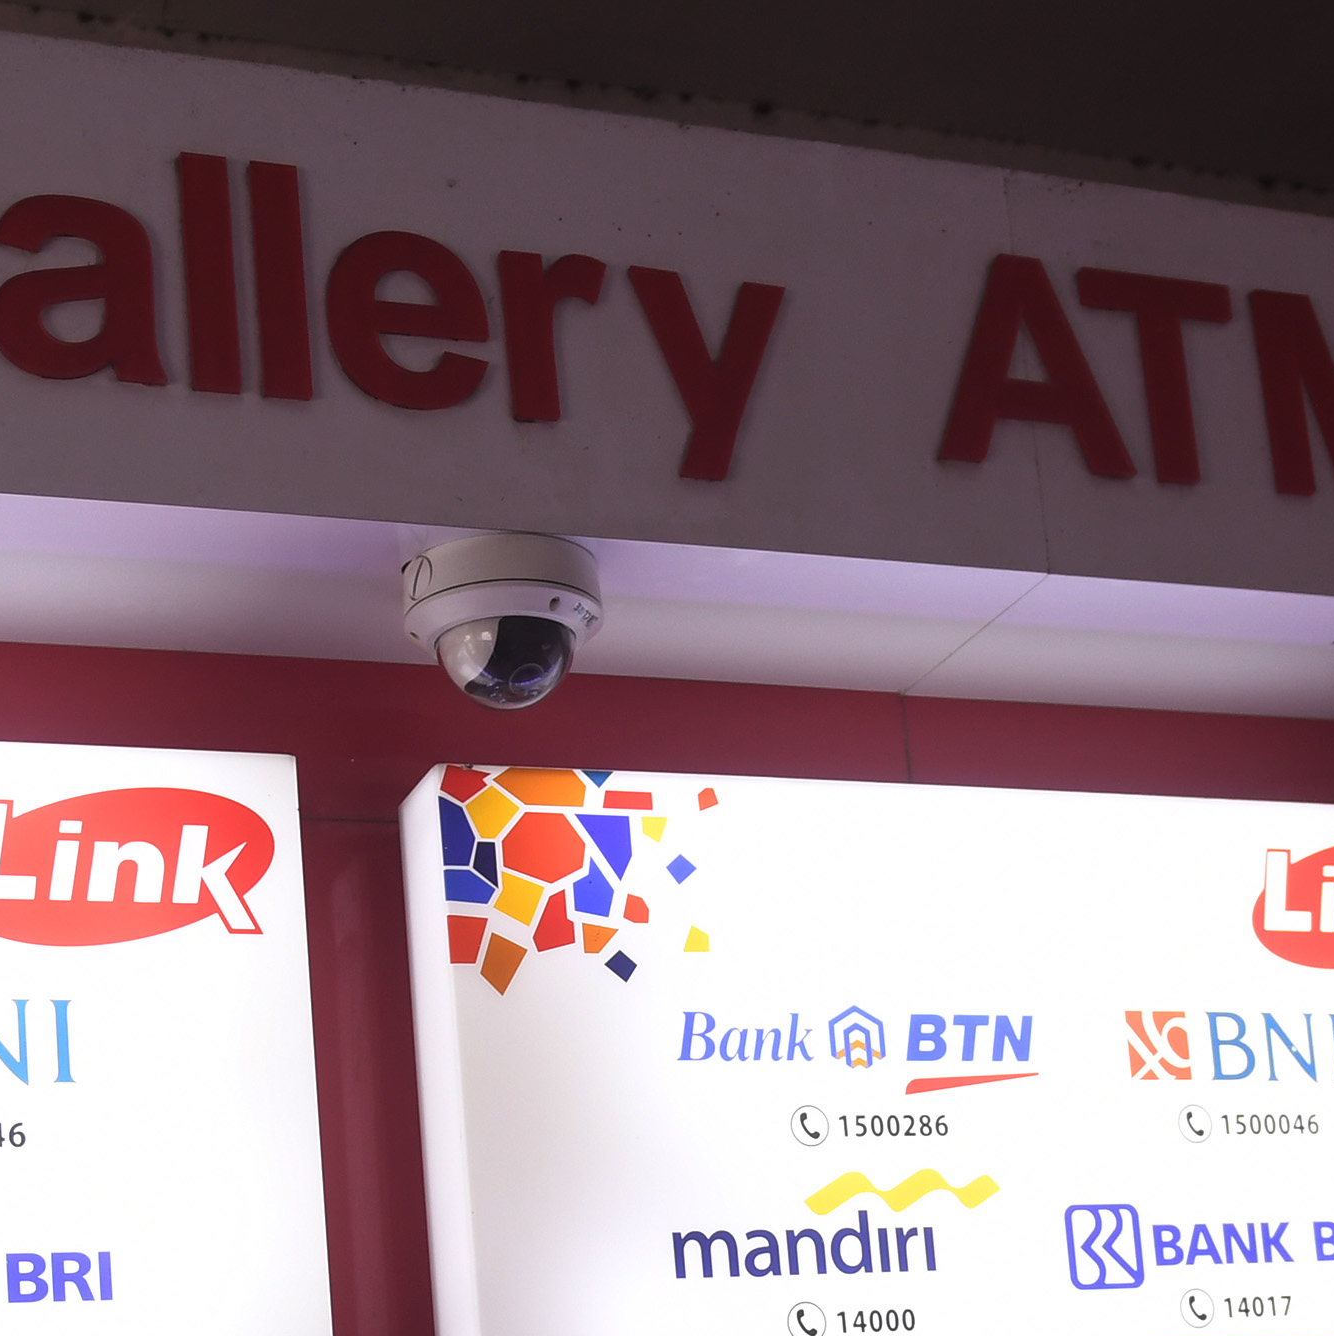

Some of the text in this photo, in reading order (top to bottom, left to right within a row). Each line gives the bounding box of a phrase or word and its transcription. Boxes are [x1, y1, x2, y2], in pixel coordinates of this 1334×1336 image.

[677, 1011, 1033, 1062] Bank BTN
[838, 1114, 949, 1138] 1500286
[1221, 1114, 1319, 1135] 1500046
[1152, 1222, 1295, 1266] BANK
[6, 1251, 113, 1303] BRI
[1224, 1295, 1292, 1319] 14017
[836, 1308, 916, 1333] 14000
